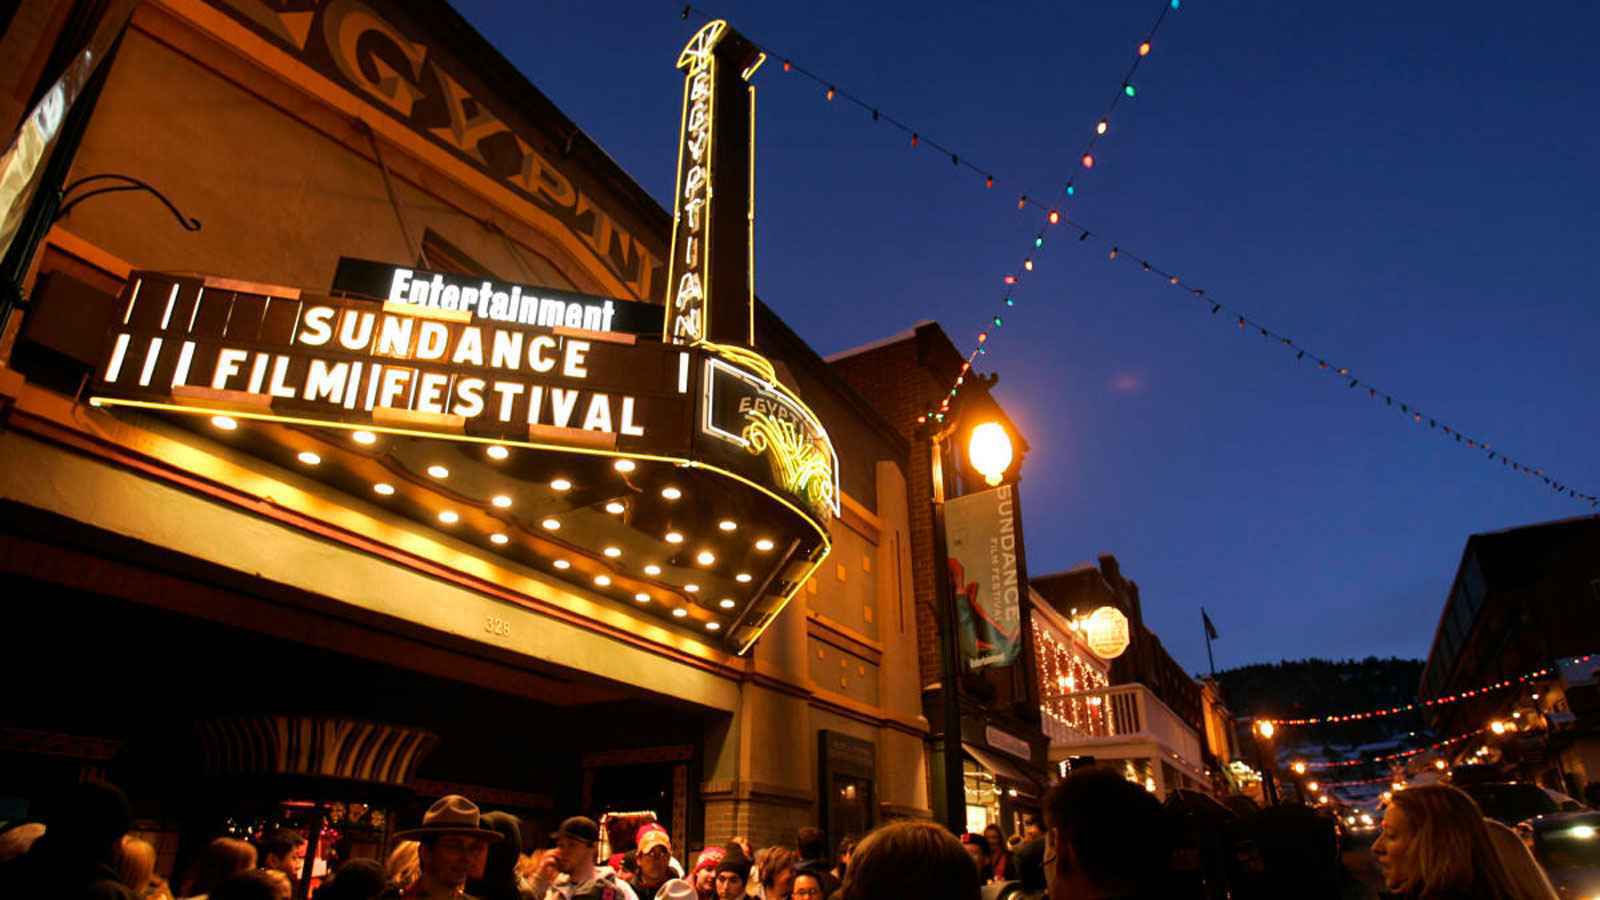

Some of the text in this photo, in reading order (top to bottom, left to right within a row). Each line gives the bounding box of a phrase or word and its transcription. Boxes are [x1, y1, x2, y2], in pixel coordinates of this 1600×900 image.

[673, 72, 707, 345] EGYPTIAN
[389, 268, 614, 332] Entertainment
[298, 307, 592, 379] SUNDANCE
[212, 347, 644, 437] FILM FESTIVAL
[989, 537, 1000, 566] FILM
[997, 485, 1020, 622] SUNDANCE
[484, 615, 512, 637] 328
